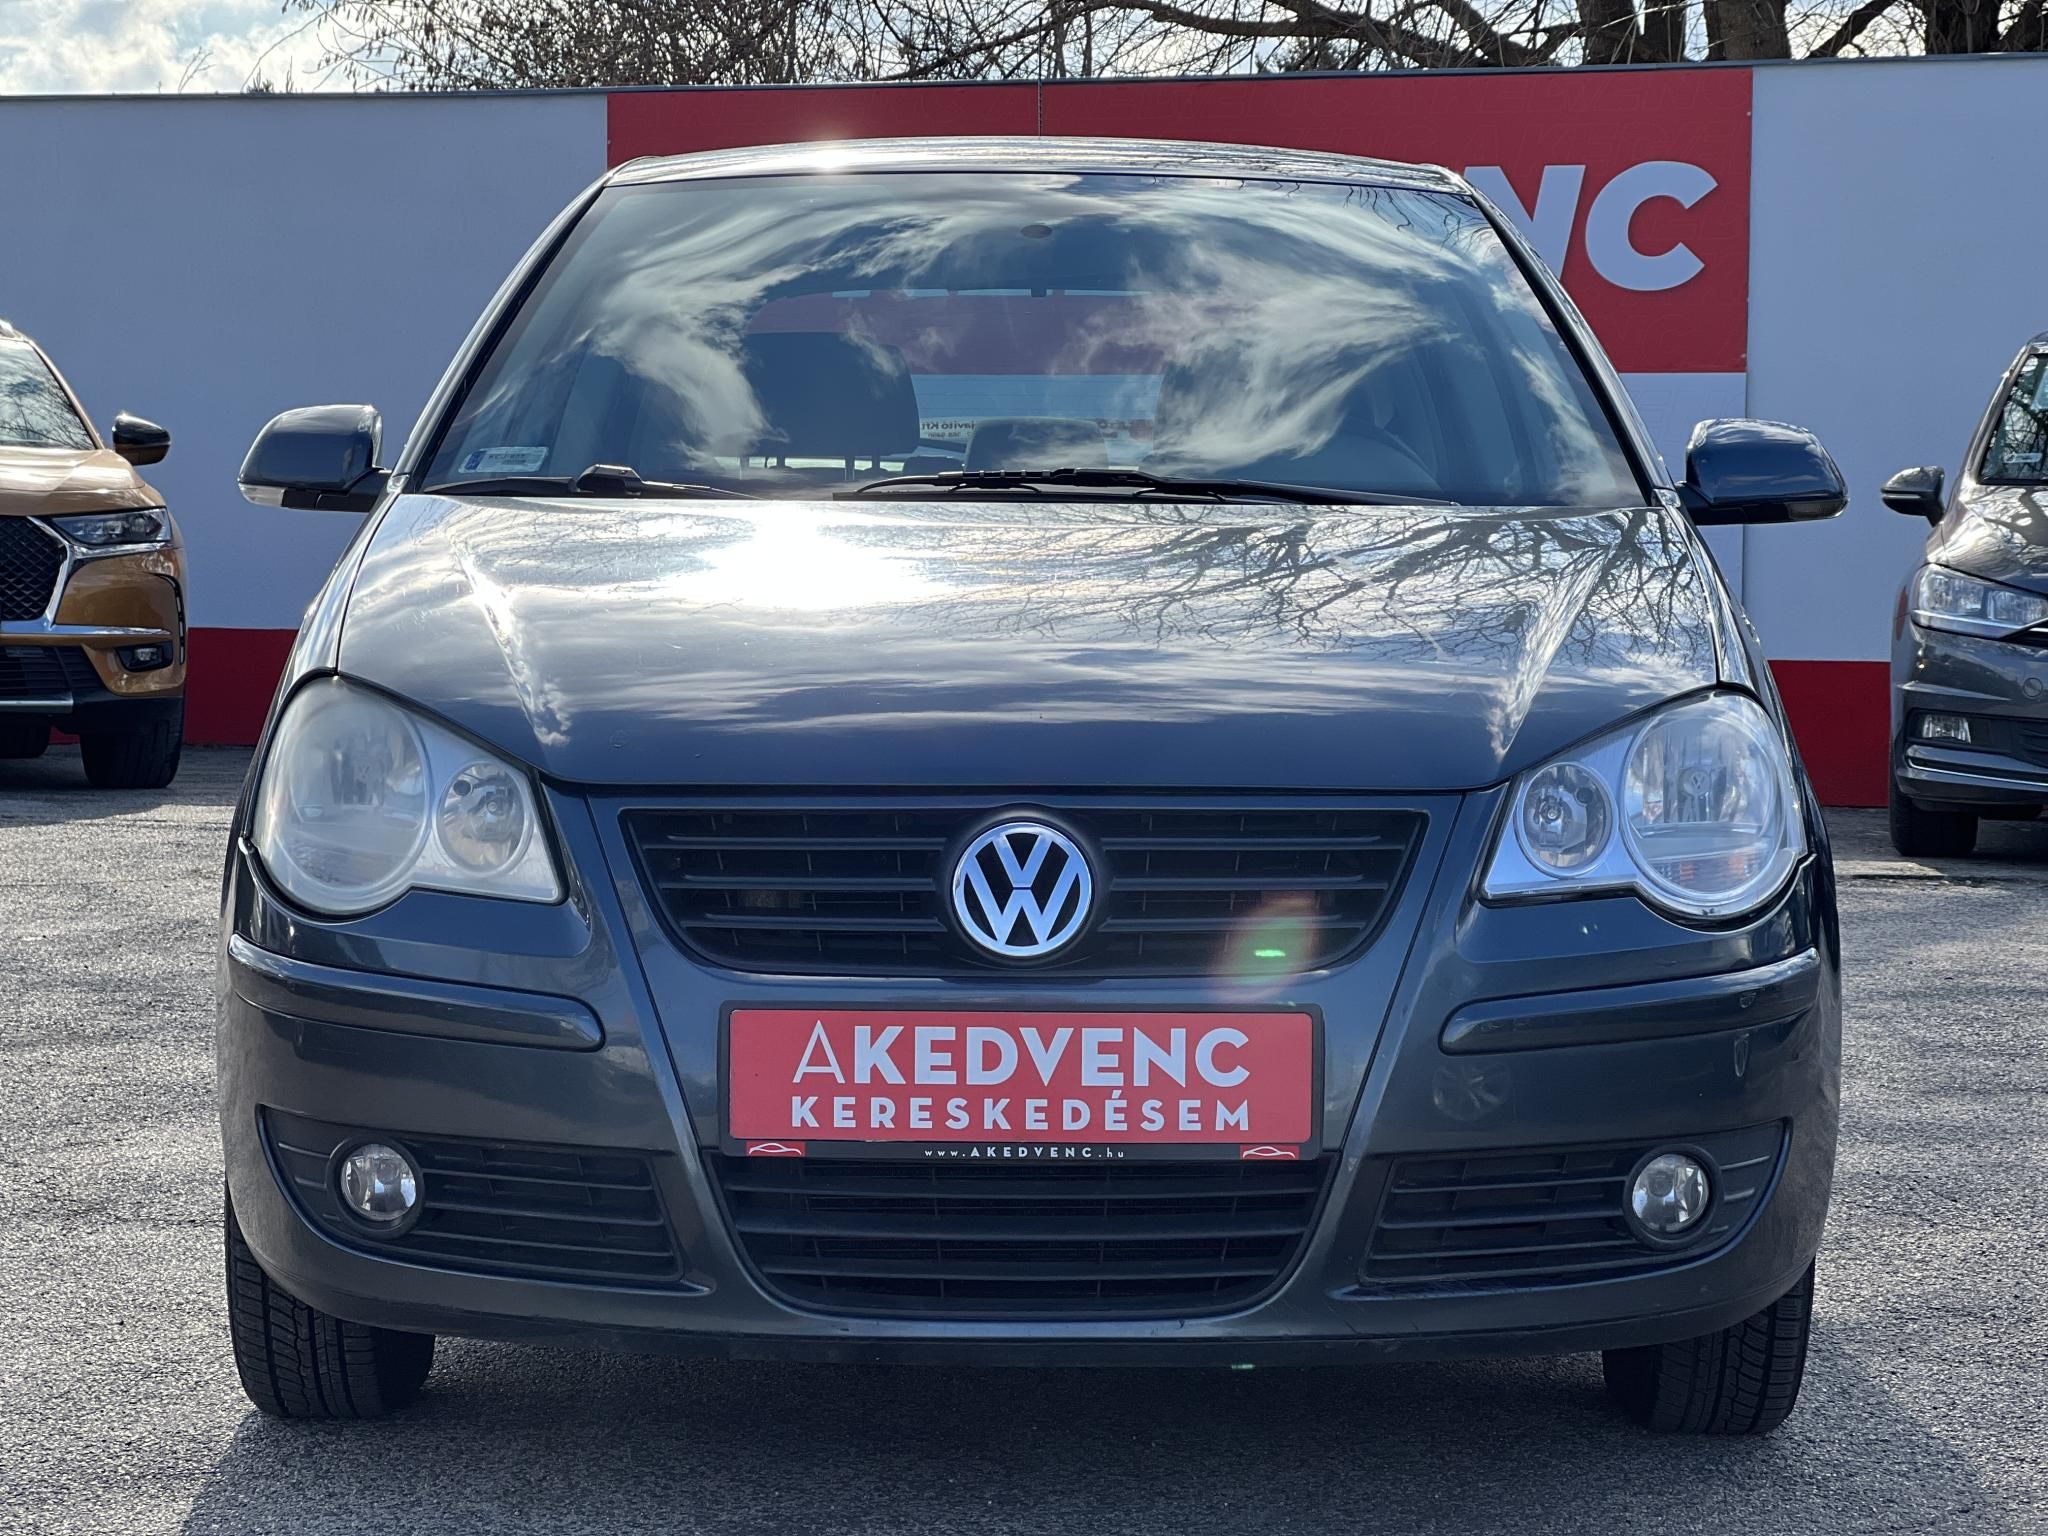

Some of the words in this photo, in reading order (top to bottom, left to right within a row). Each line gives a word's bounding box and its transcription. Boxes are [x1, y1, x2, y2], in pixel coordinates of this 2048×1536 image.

[792, 1019, 1251, 1087] AKEDVENC
[791, 1091, 1250, 1131] KERESKEDÉSEM
[924, 1146, 1125, 1158] www.AKEDVENC.hu
